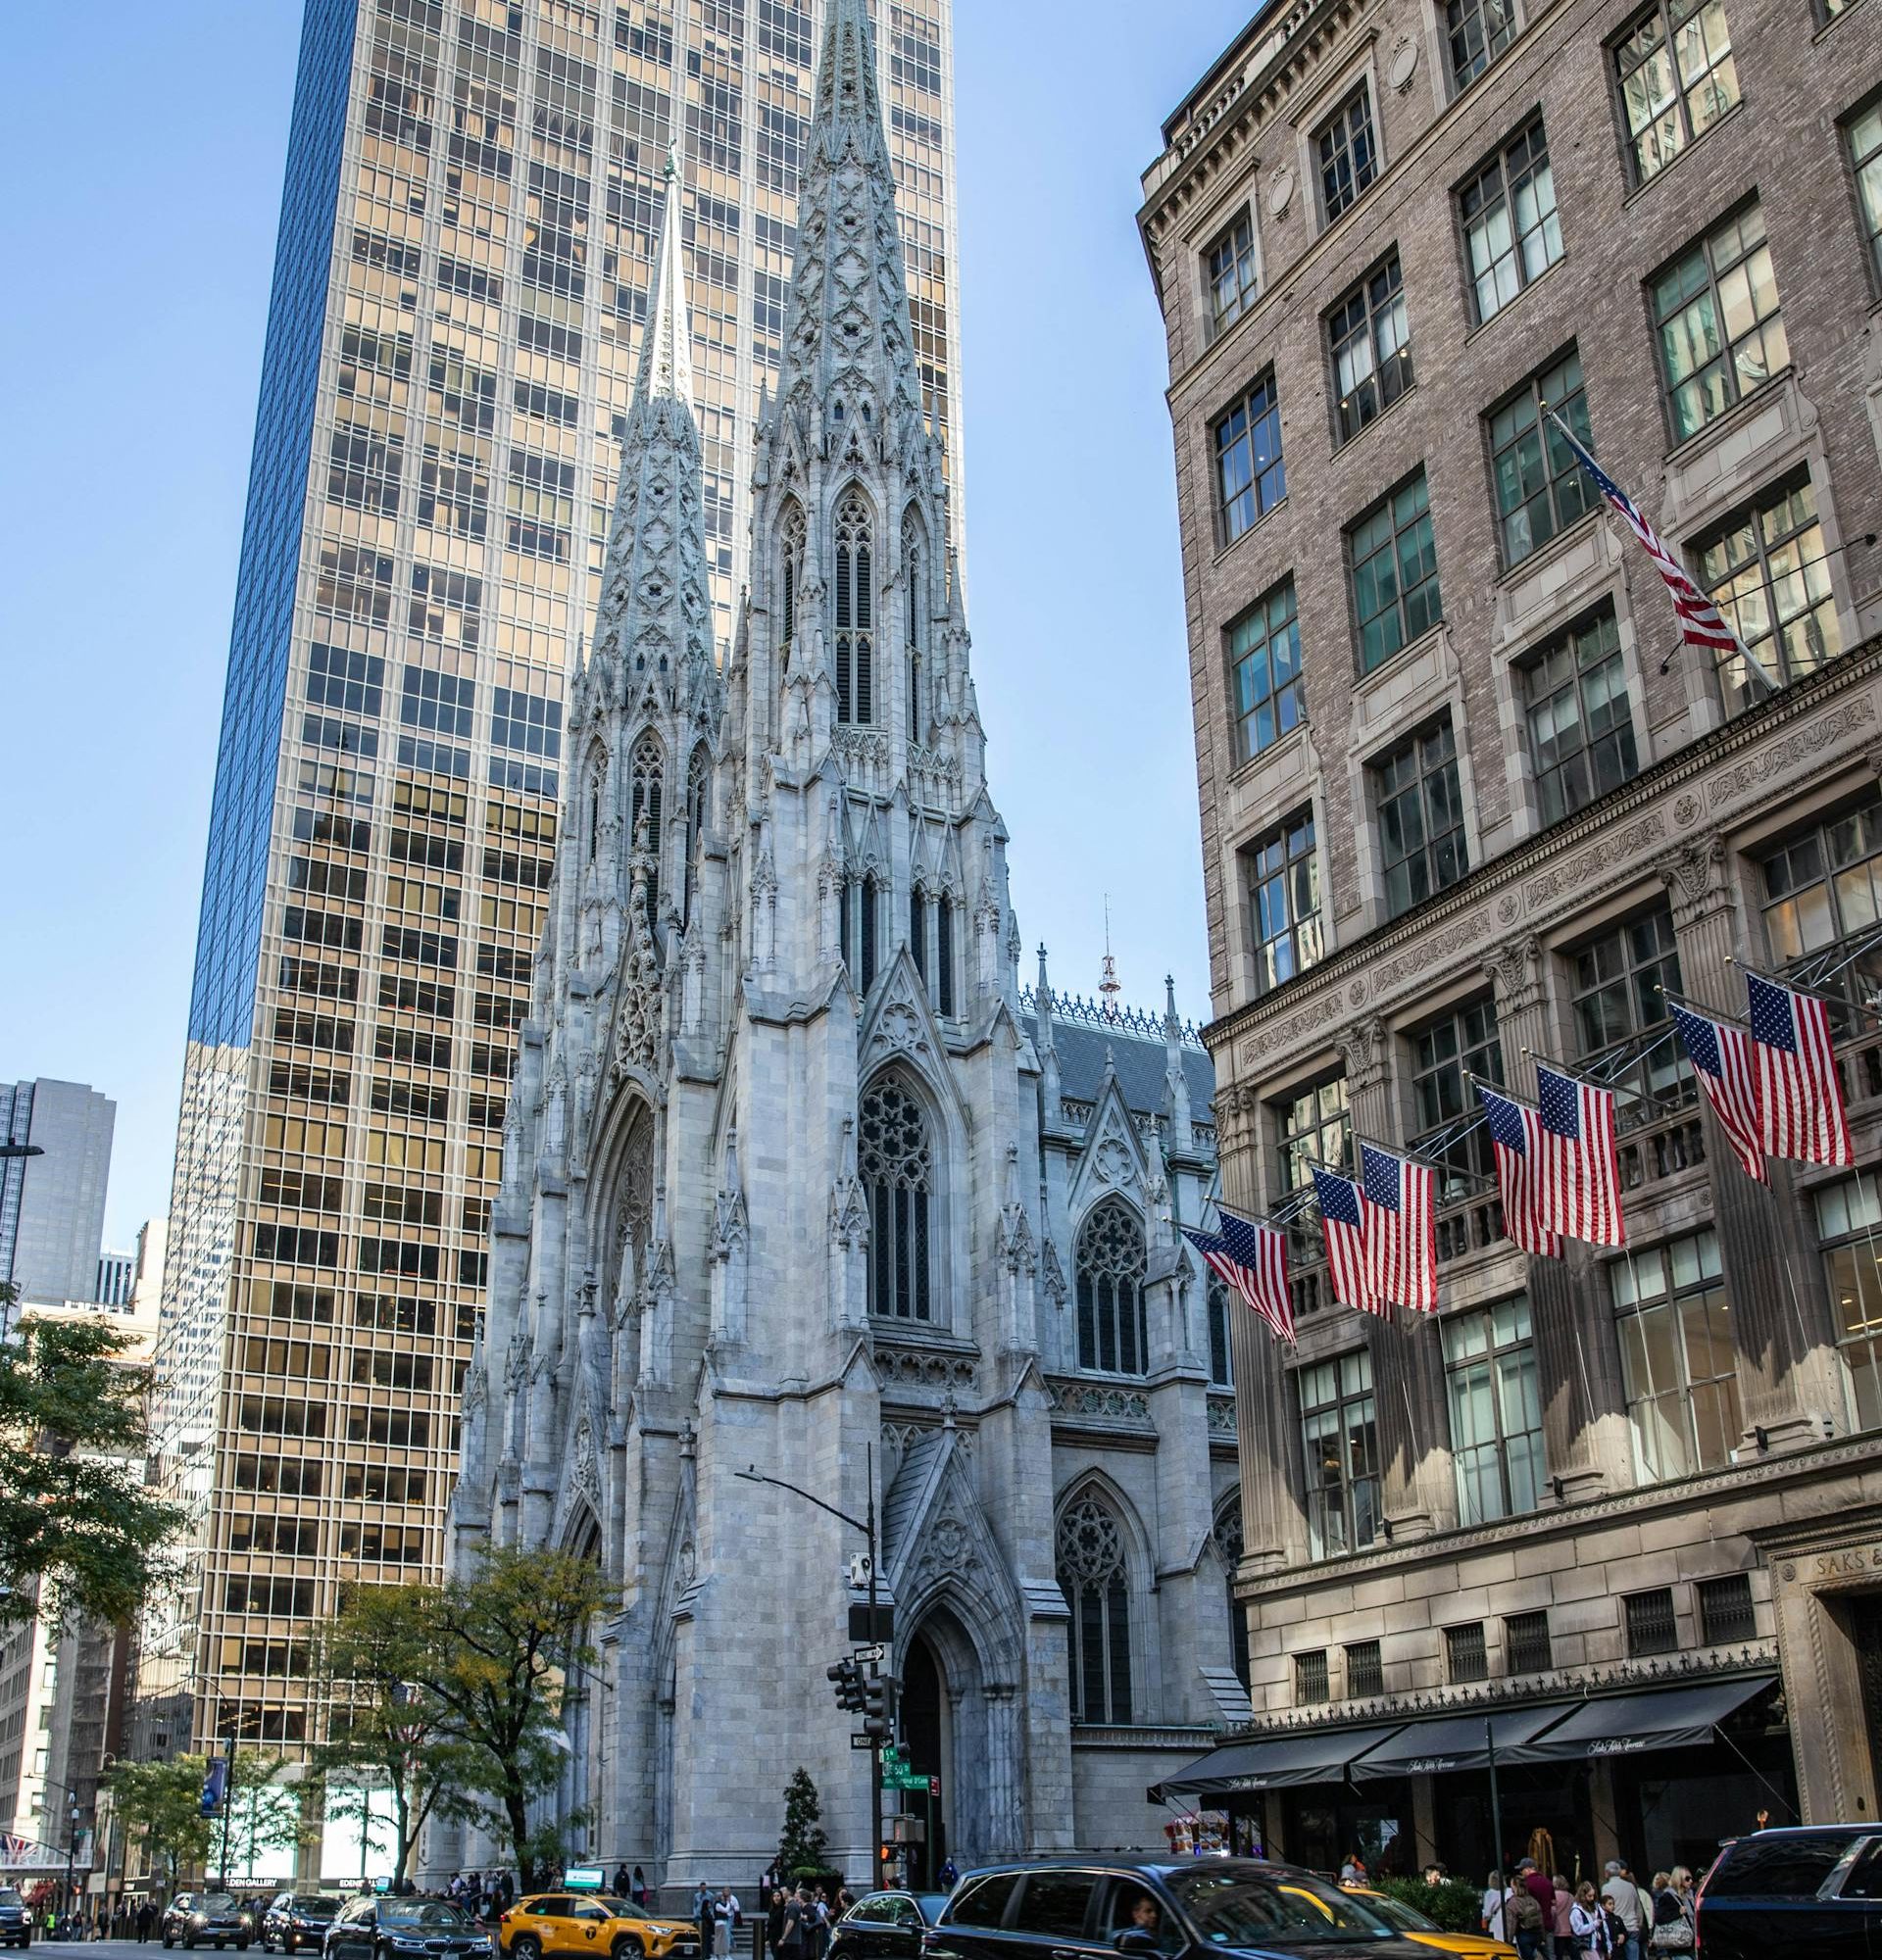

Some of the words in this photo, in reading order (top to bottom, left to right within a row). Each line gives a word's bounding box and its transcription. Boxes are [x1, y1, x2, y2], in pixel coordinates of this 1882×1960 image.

[1817, 1551, 1864, 1574] SAKS
[894, 1764, 904, 1775] 50
[245, 1879, 277, 1887] GALLERY
